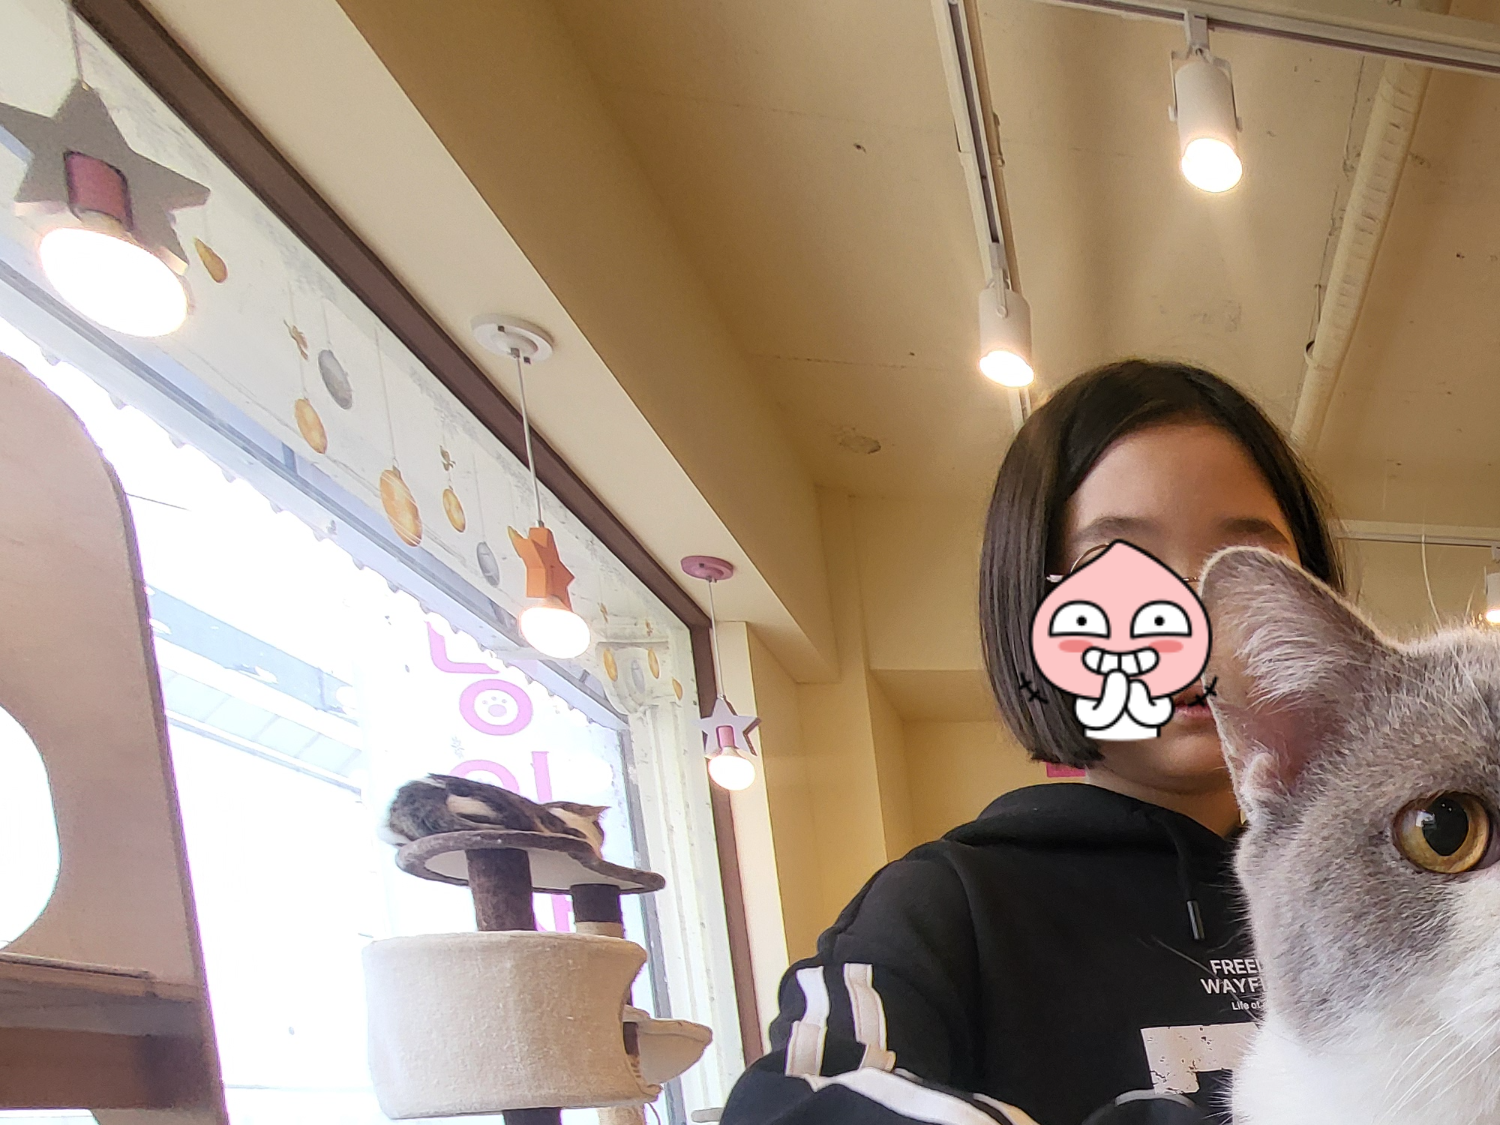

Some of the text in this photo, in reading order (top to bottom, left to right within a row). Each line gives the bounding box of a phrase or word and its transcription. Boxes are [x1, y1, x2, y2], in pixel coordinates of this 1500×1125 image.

[1210, 958, 1261, 975] FREE
[1200, 977, 1266, 994] WAYF
[1231, 1001, 1249, 1010] Life
